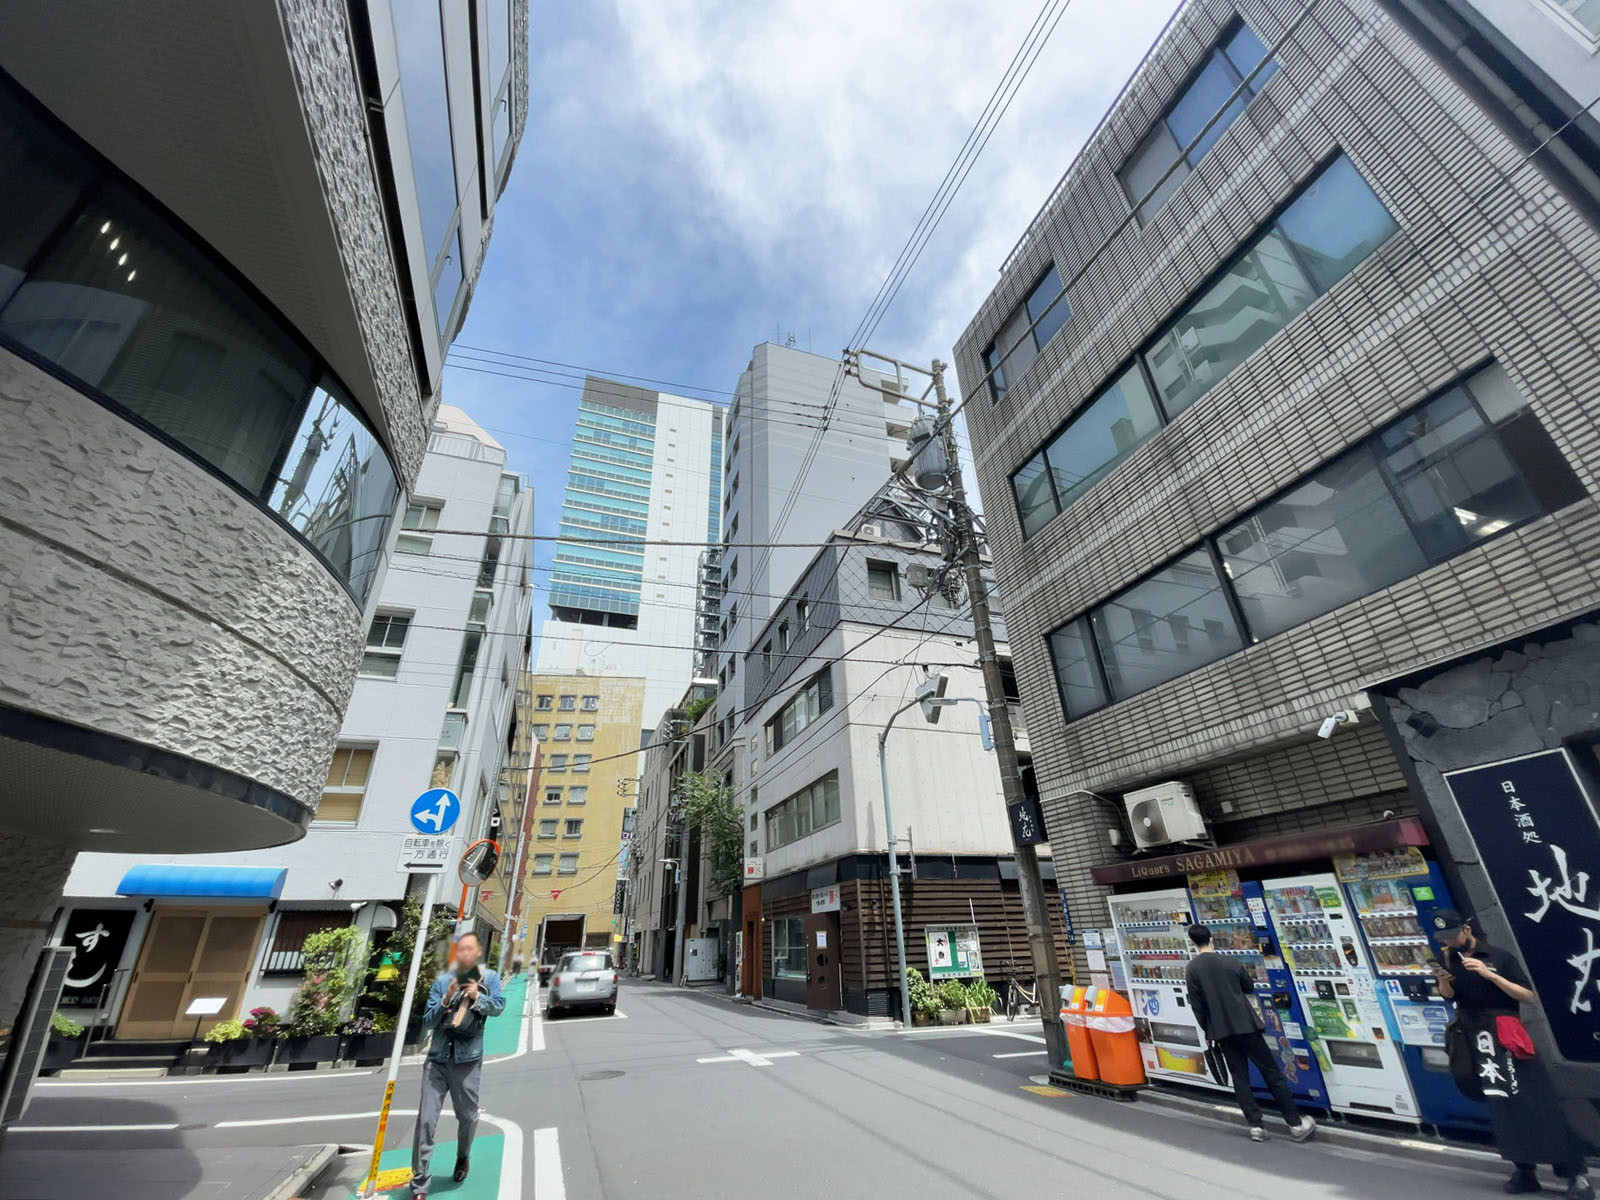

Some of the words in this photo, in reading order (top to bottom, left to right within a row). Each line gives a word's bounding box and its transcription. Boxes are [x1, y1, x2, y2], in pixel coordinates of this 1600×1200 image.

[1500, 780, 1543, 844] 日本酒処
[402, 849, 449, 860] 一方通行
[1176, 848, 1256, 872] SAGAMIYA
[1477, 1031, 1509, 1098] 日本一
